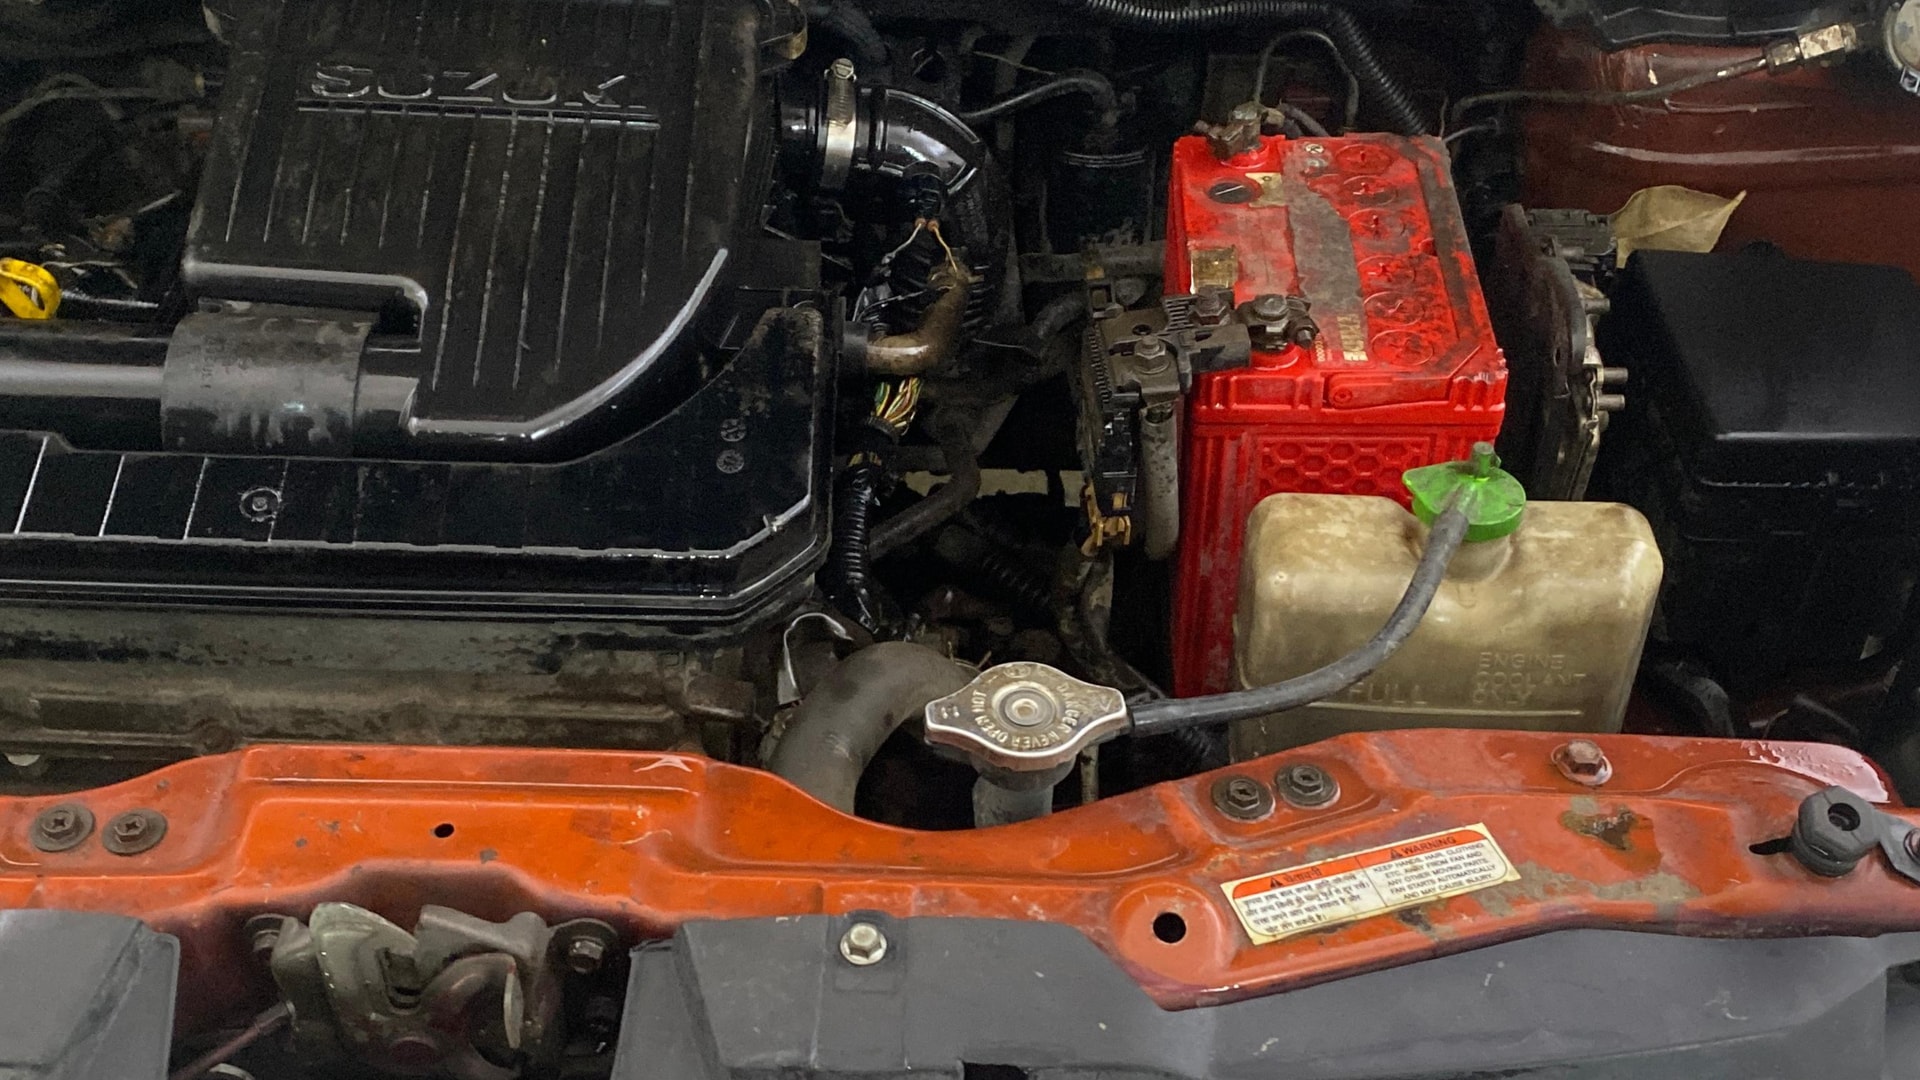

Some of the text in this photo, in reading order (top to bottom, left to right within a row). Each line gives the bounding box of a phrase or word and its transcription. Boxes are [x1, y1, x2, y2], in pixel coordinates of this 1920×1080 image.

[309, 62, 648, 109] SUZUK
[1480, 651, 1567, 670] ENGINE
[1474, 670, 1587, 688] COOLANT
[971, 682, 1081, 749] DANGER NEVER OPEN HOT
[1401, 836, 1457, 854] WARNING
[1373, 864, 1394, 872] KEEP
[1403, 865, 1425, 873] AWAY
[1425, 859, 1448, 867] FROM
[1403, 872, 1431, 881] OTHER
[1432, 864, 1462, 874] MOVING
[1389, 864, 1496, 894] FAN STARTS AUTOMATICALLY
[1437, 880, 1463, 890] CAUSE
